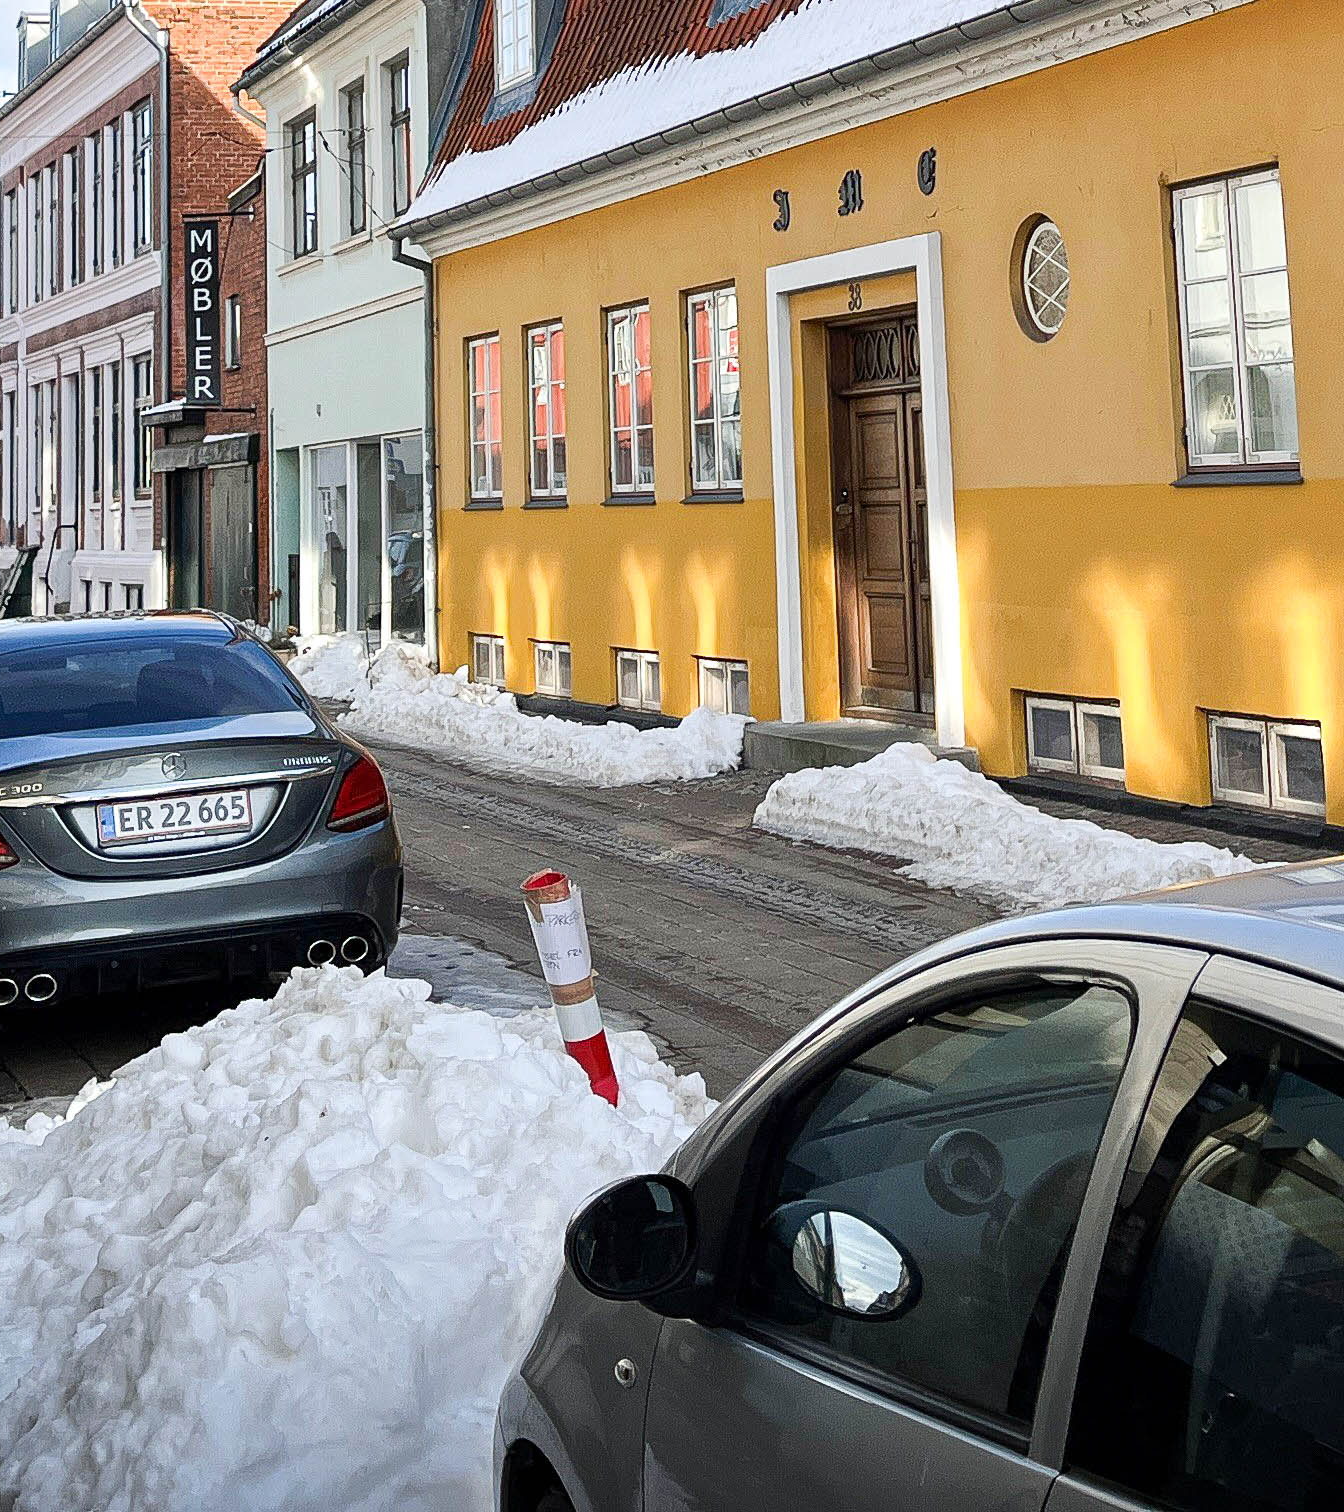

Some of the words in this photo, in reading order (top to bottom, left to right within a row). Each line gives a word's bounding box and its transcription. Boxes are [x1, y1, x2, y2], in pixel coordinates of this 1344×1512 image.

[848, 282, 862, 311] 38
[190, 229, 215, 399] MØBLER
[12, 783, 43, 795] 300
[119, 806, 154, 832] ER
[160, 801, 192, 828] 22
[198, 795, 245, 824] 665
